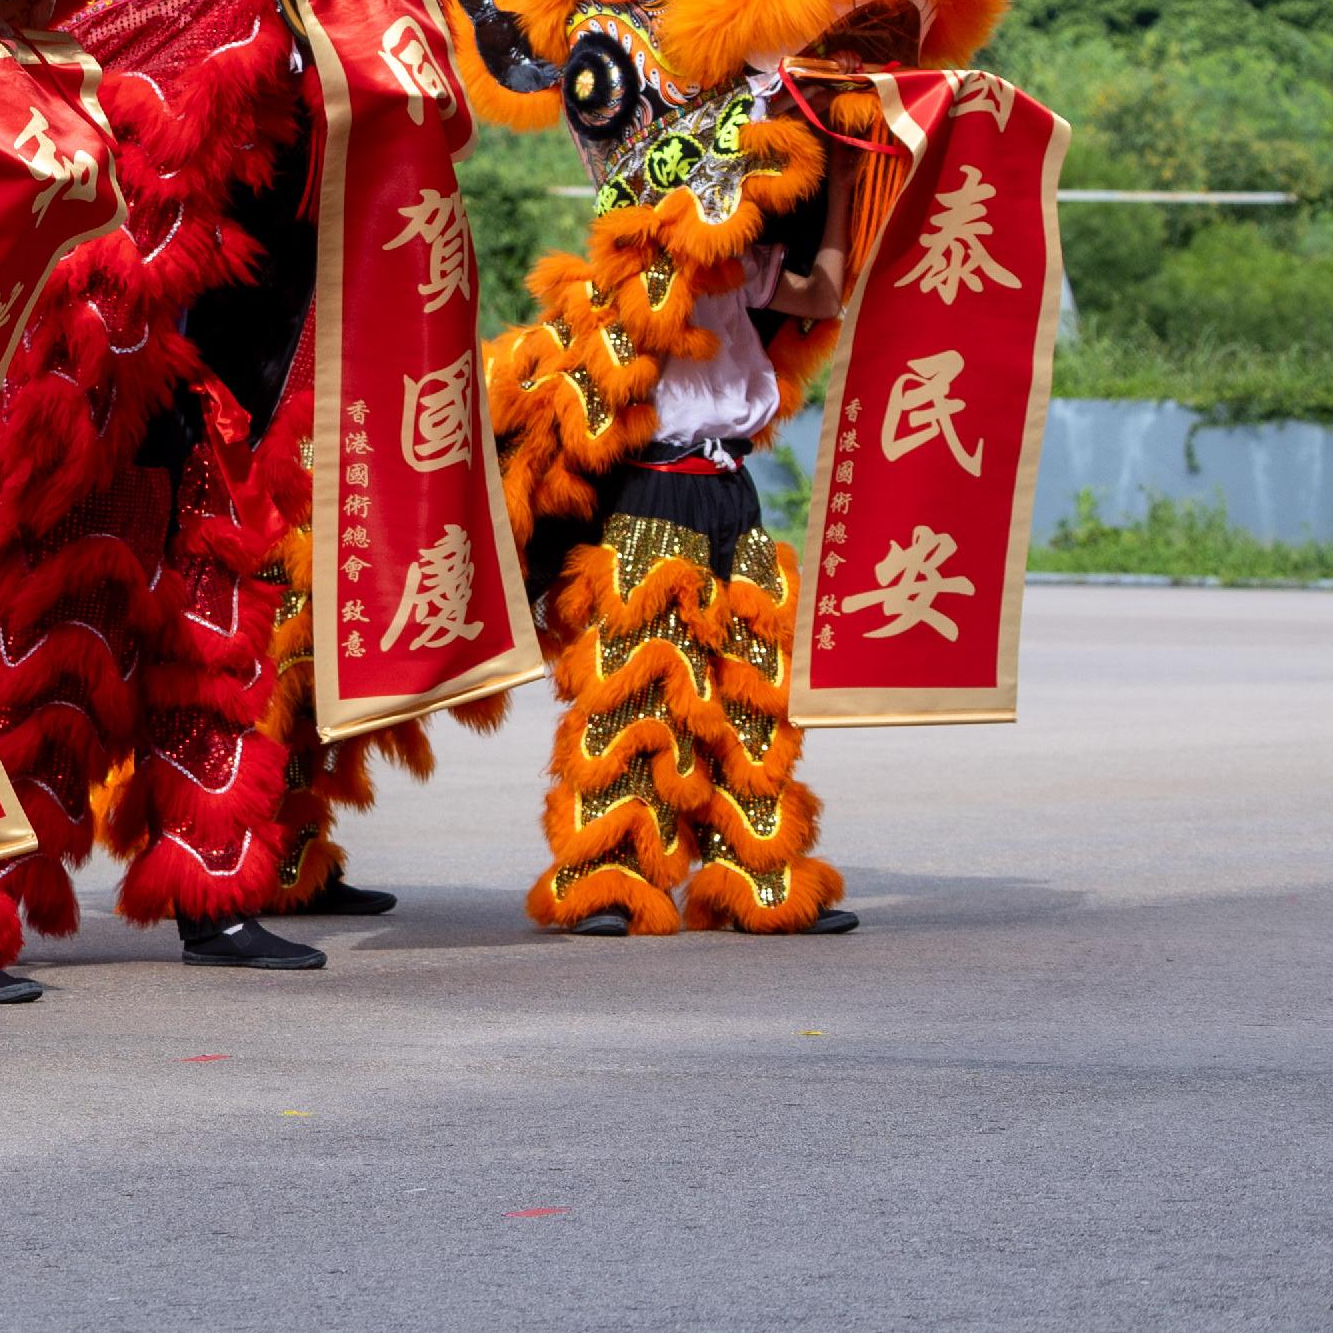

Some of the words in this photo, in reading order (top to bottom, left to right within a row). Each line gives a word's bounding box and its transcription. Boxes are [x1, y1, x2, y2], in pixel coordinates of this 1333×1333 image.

[378, 15, 485, 652] 同賀國慶
[340, 399, 374, 584] 香港國術總會
[821, 397, 863, 579] 香港國術總會
[341, 598, 370, 658] 致意
[814, 594, 841, 651] 致意
